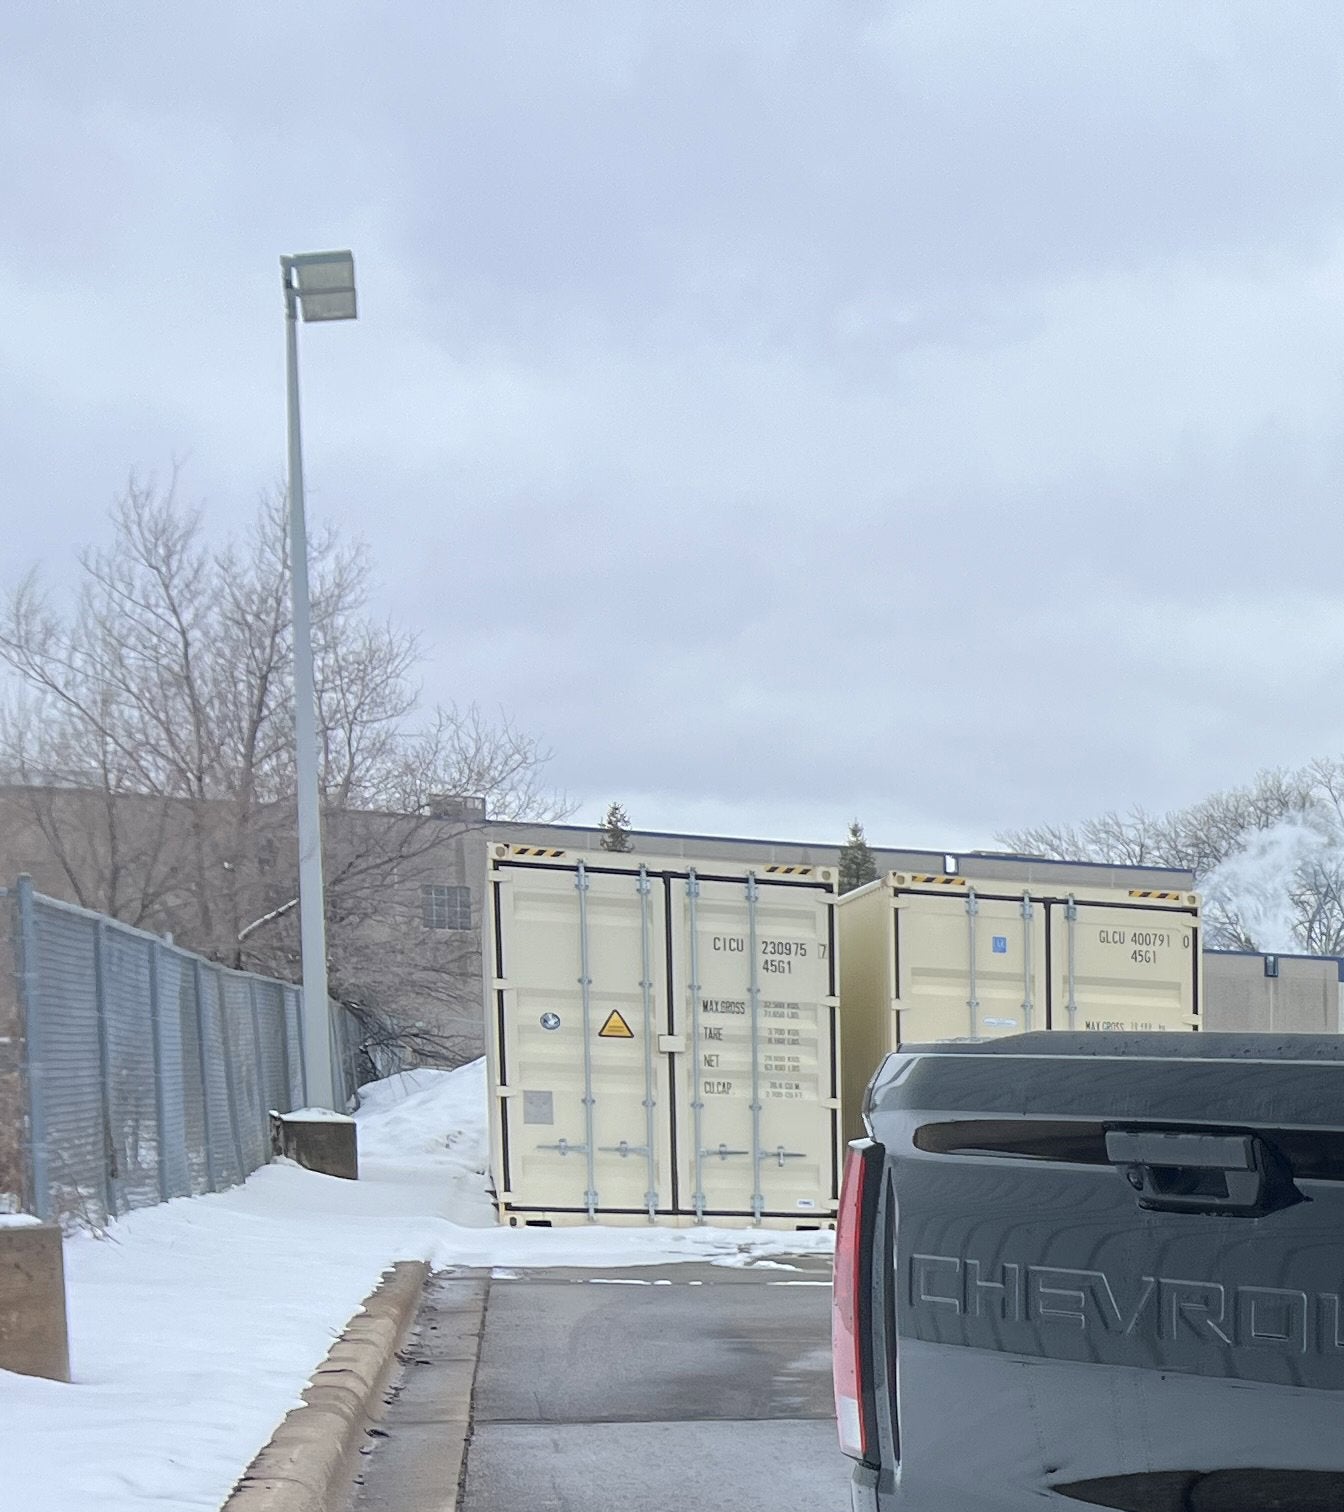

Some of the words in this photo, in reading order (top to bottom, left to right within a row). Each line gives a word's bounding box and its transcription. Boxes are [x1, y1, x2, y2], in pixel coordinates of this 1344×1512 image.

[1099, 930, 1125, 944] GLCU
[1131, 932, 1170, 947] 400791
[713, 937, 744, 952] CICU
[761, 941, 807, 956] 230975
[1131, 950, 1156, 963] 45G1
[762, 959, 792, 974] 45G1
[704, 1027, 723, 1040] TARE
[704, 1054, 720, 1067] NET
